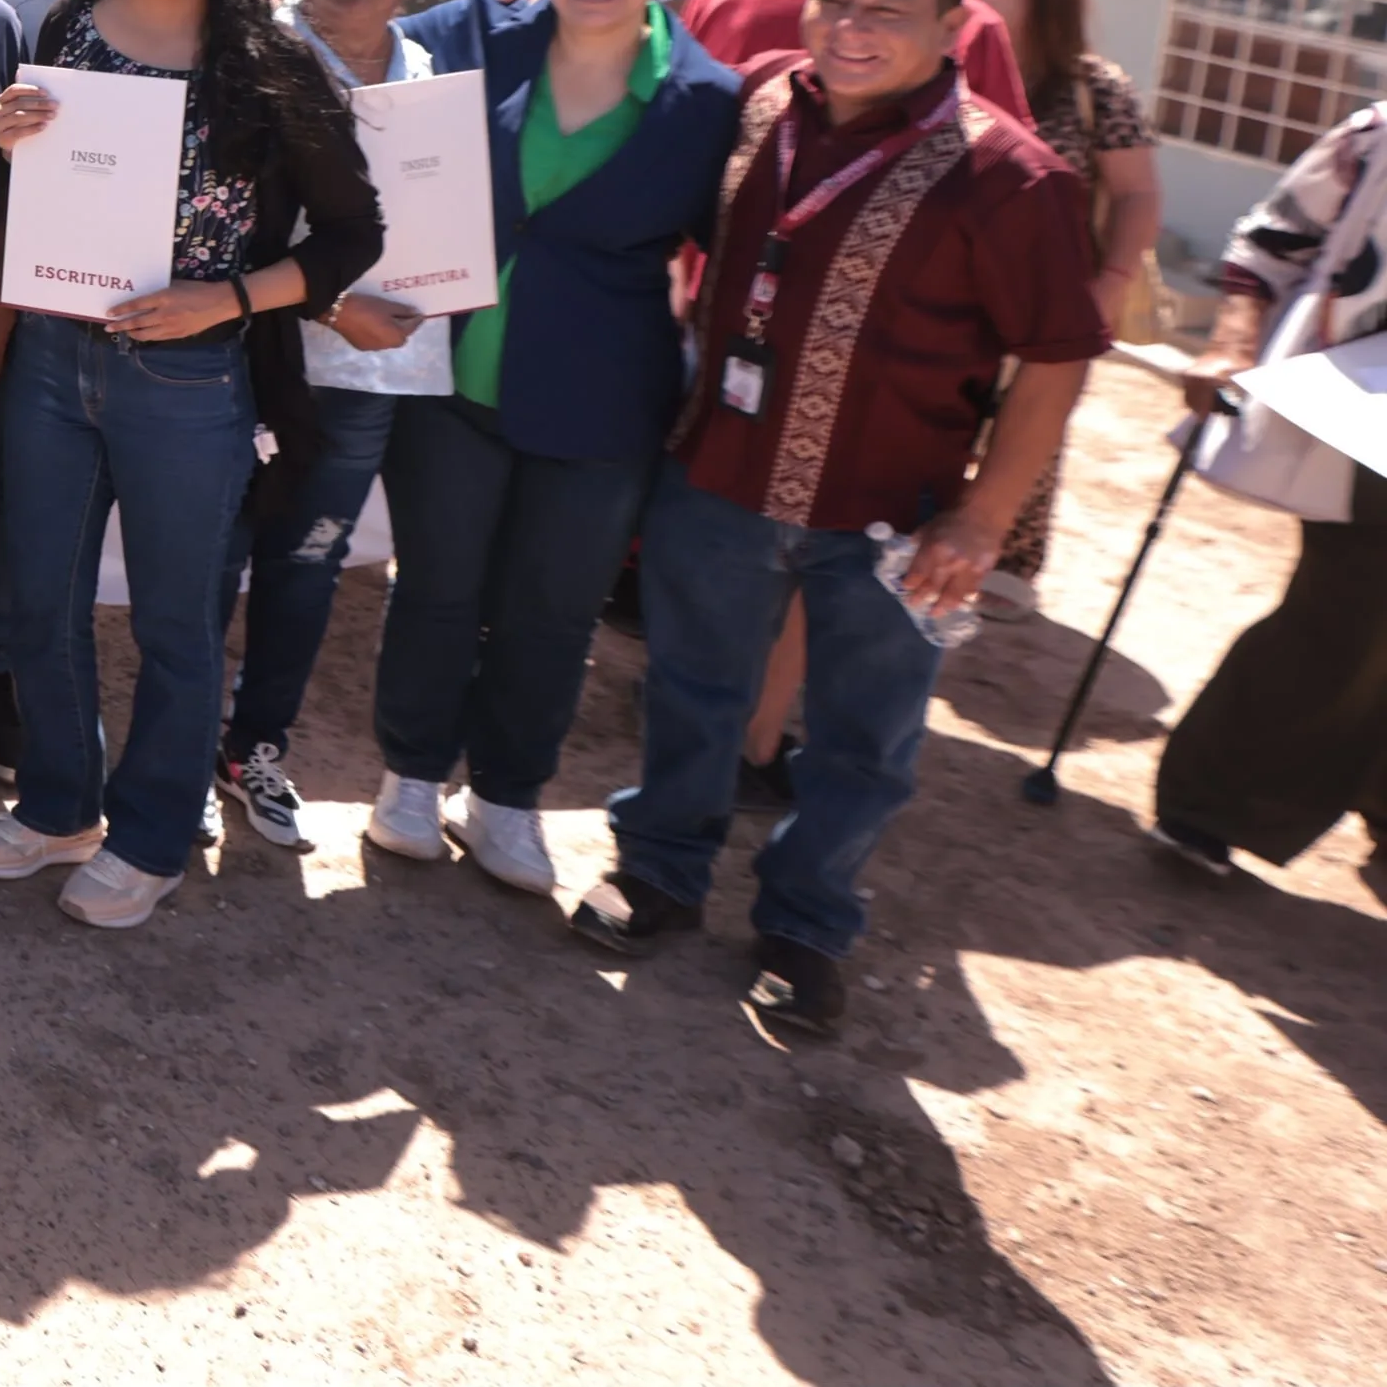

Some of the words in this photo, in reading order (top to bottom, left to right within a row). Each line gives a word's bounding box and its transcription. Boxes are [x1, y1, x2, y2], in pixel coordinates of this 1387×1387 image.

[70, 150, 118, 166] INSUS
[399, 156, 441, 173] INSUS
[34, 265, 135, 291] ESCRITURA
[380, 268, 470, 292] ESCRITURA
